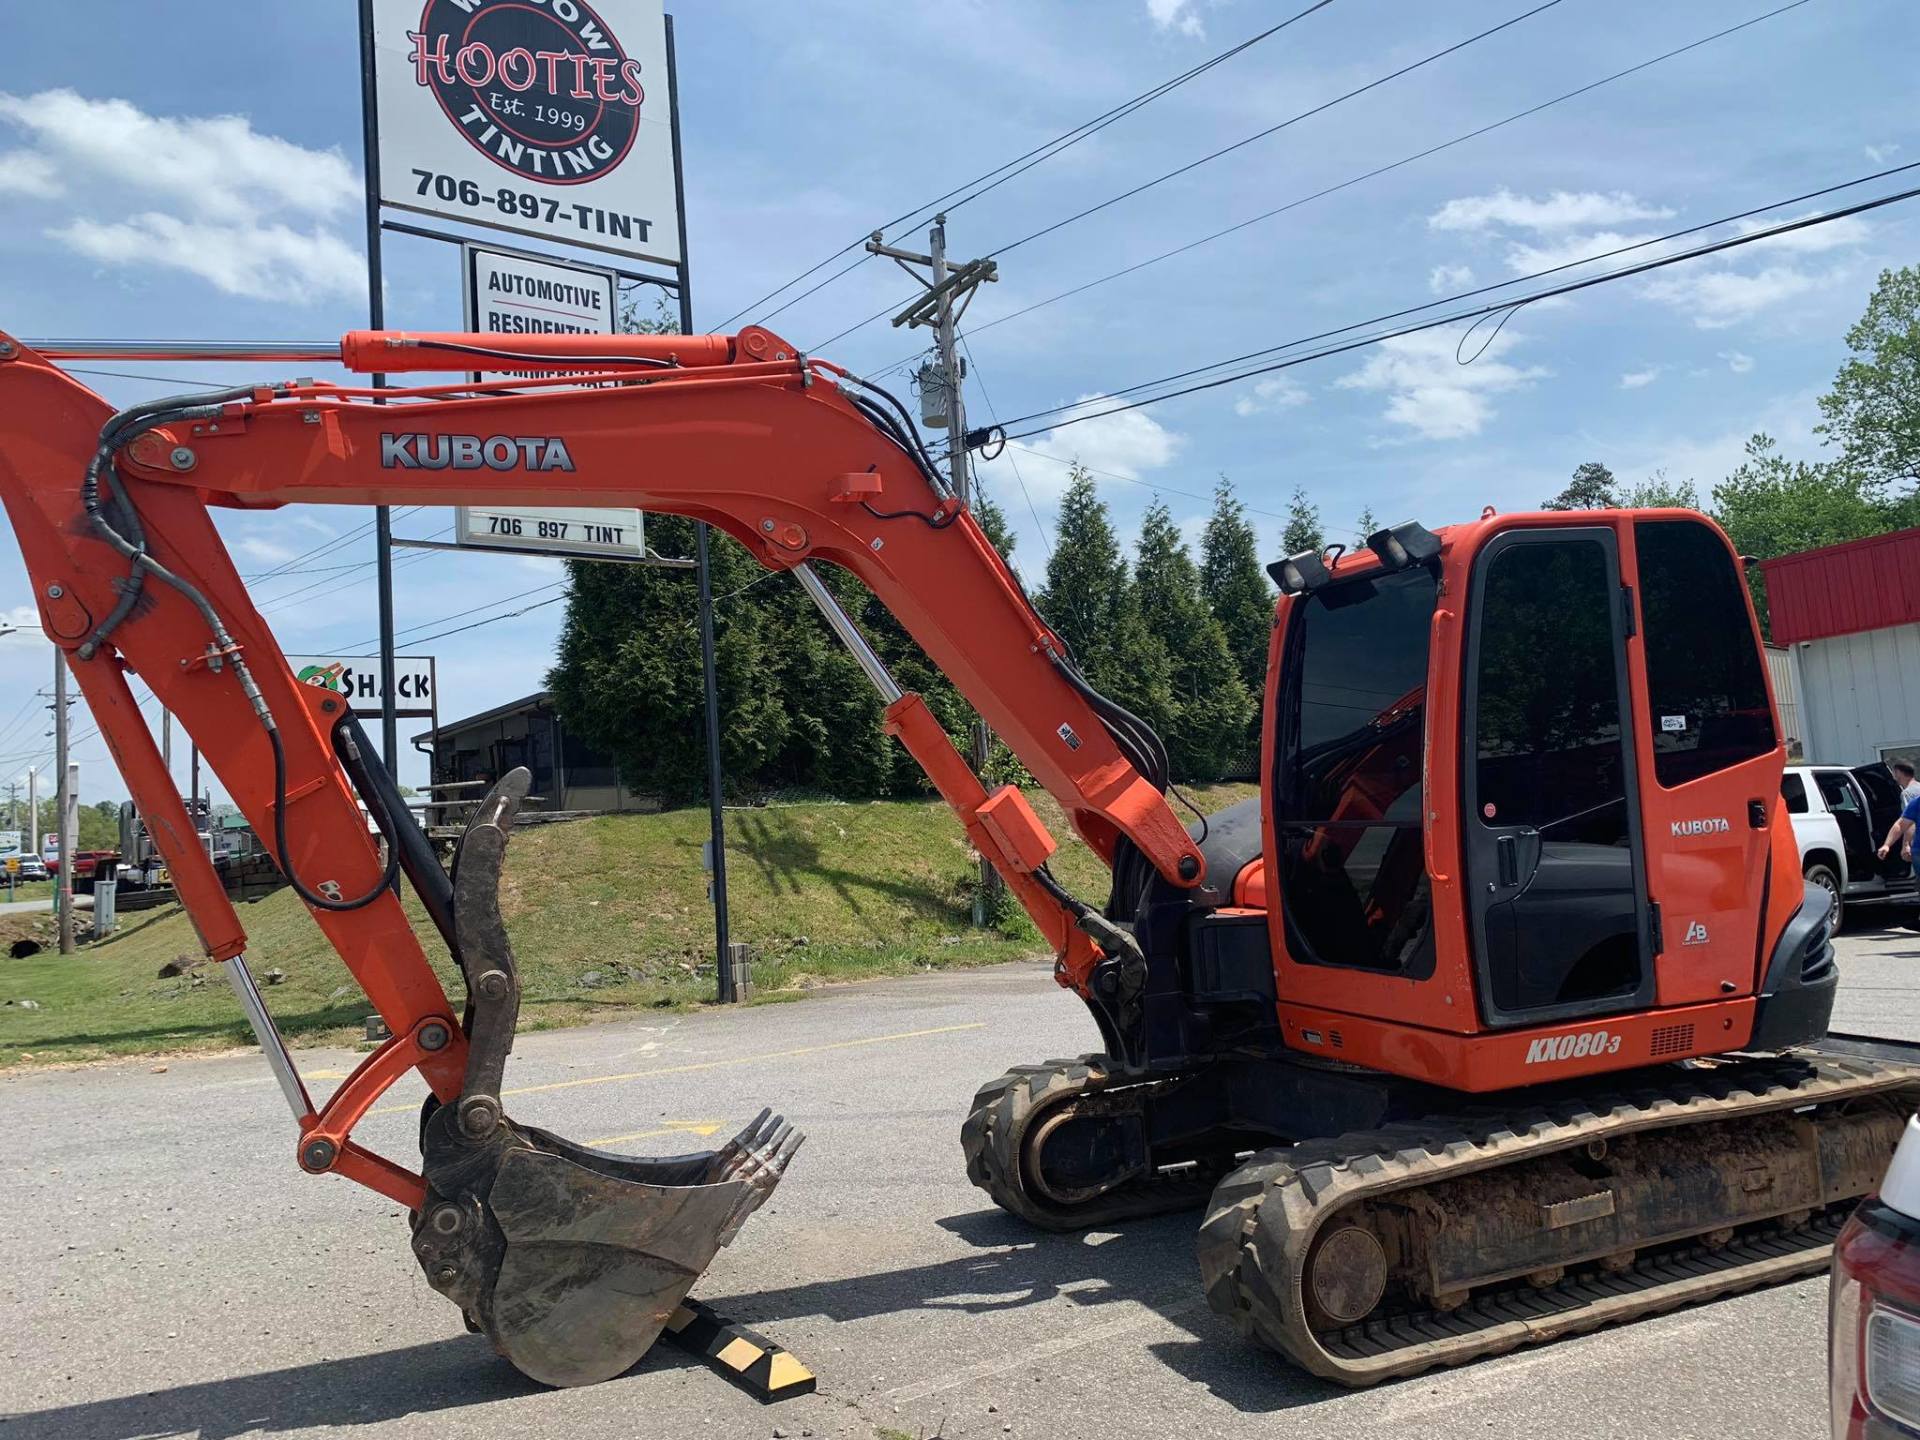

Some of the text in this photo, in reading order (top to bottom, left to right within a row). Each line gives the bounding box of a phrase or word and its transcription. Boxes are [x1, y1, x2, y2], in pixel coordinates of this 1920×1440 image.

[406, 31, 645, 106] HOOTIES
[488, 92, 586, 131] Est. 1999
[460, 104, 614, 176] TINTING
[411, 168, 653, 243] 706-897-TINT
[488, 270, 601, 310] AUTOMOTIVE
[488, 311, 599, 335] RESIDEN
[380, 433, 576, 472] KUBOTA
[489, 517, 624, 544] 706 897 TINT
[341, 667, 430, 699] SHCK
[1671, 818, 1731, 837] KUBOTA
[1525, 1030, 1622, 1065] KX080-3
